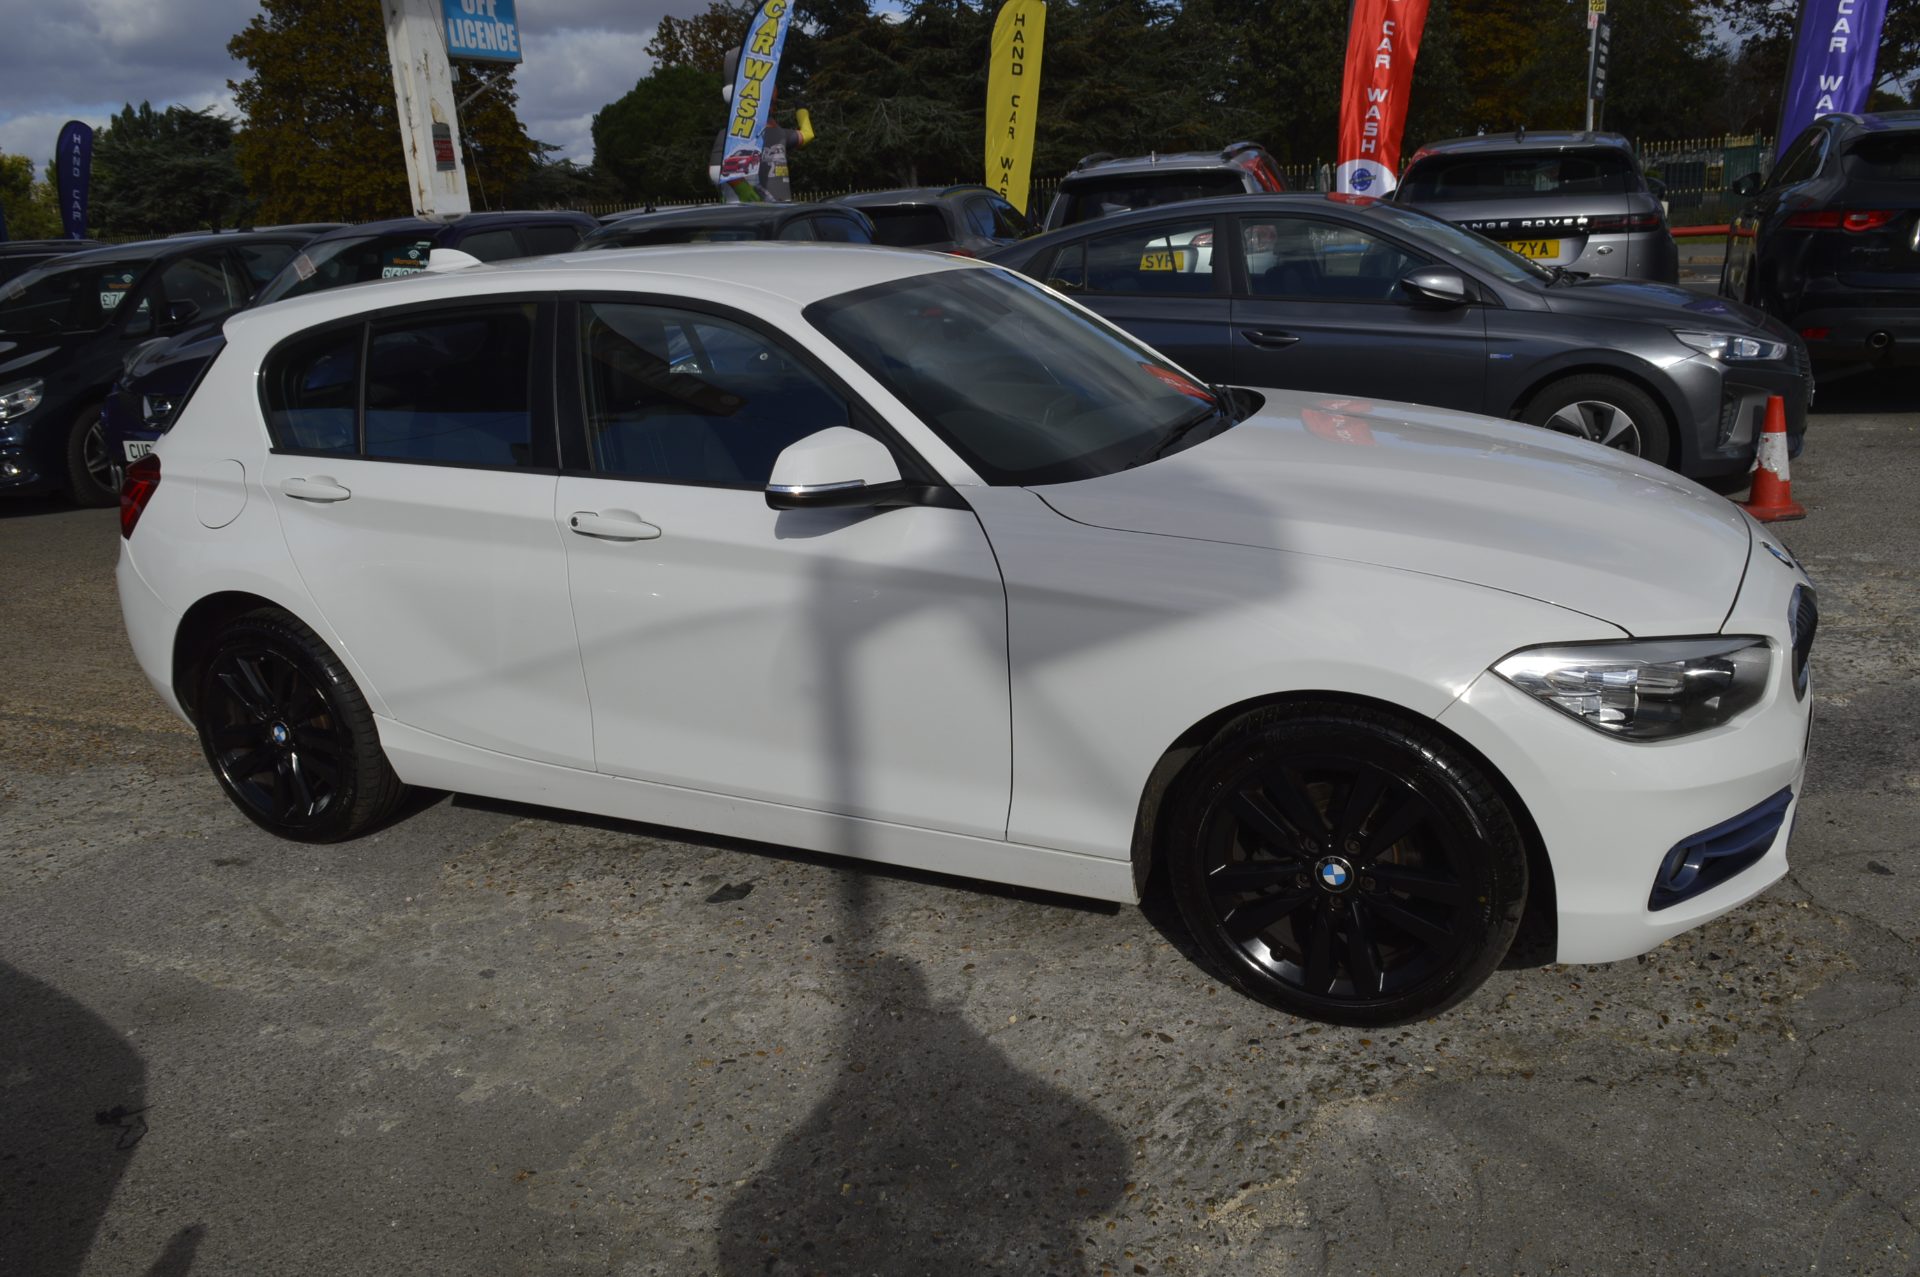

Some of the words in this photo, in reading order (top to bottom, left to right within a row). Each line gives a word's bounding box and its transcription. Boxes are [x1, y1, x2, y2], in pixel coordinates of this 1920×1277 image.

[448, 18, 518, 52] LICENCE
[752, 0, 787, 56] CAR
[1012, 13, 1026, 76] HAND
[1374, 20, 1395, 69] CAR
[1829, 0, 1856, 53] CAR
[731, 57, 773, 138] WASH
[1008, 95, 1020, 140] CAR
[1361, 87, 1388, 153] WASH
[72, 133, 81, 177] HAND
[1000, 156, 1014, 199] WAS
[72, 190, 81, 220] CAR
[1522, 218, 1588, 227] ROVER
